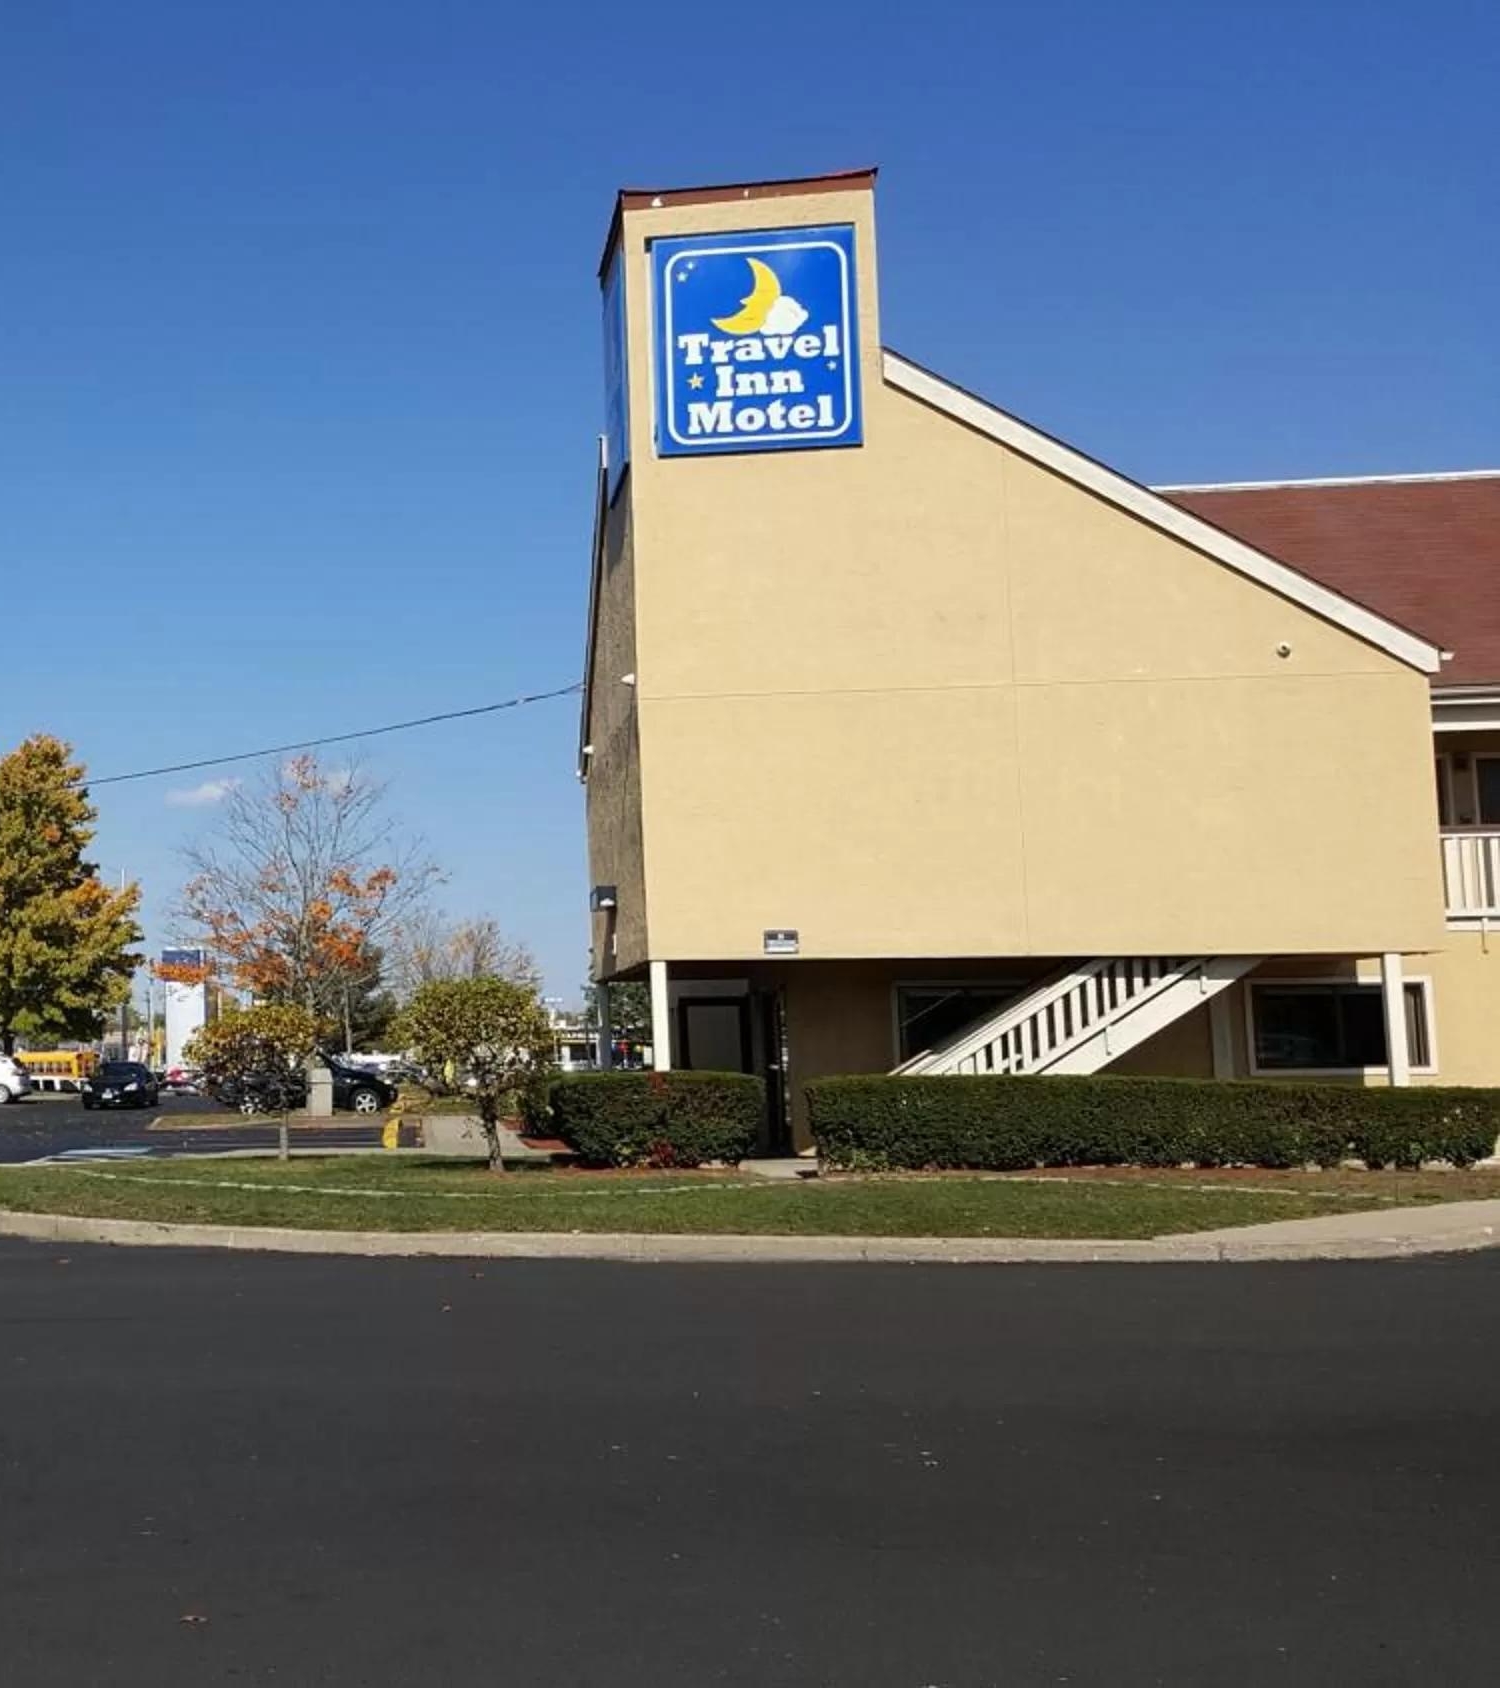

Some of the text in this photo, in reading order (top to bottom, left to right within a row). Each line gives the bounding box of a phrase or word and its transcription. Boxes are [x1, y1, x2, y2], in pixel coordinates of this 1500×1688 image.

[677, 324, 839, 366] Travel
[715, 365, 804, 397] Inn
[687, 395, 834, 435] Motel
